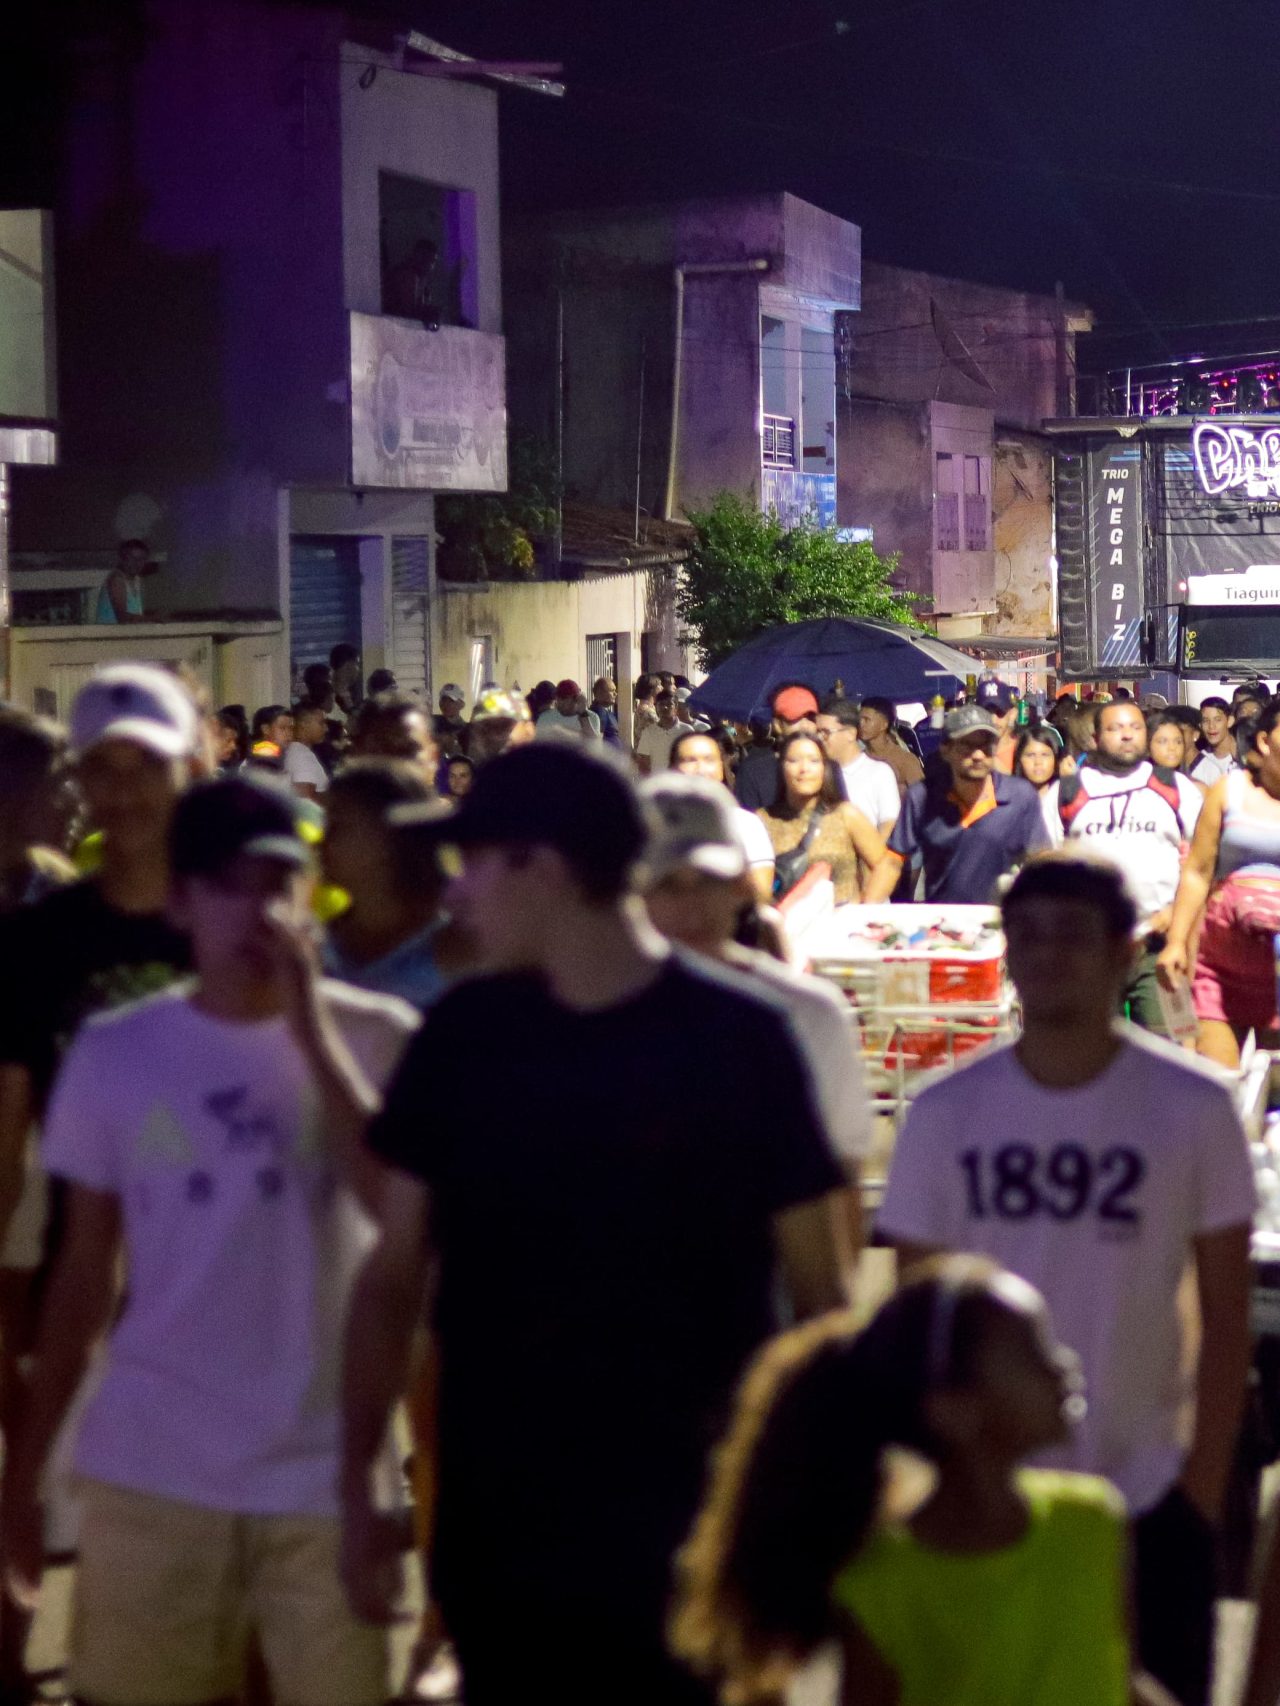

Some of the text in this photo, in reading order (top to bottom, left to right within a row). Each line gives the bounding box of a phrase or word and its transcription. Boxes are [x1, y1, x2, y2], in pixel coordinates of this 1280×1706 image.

[1101, 469, 1129, 479] TRIO
[1106, 487, 1127, 641] MEGA BIZ
[961, 1145, 1144, 1220] 1892
